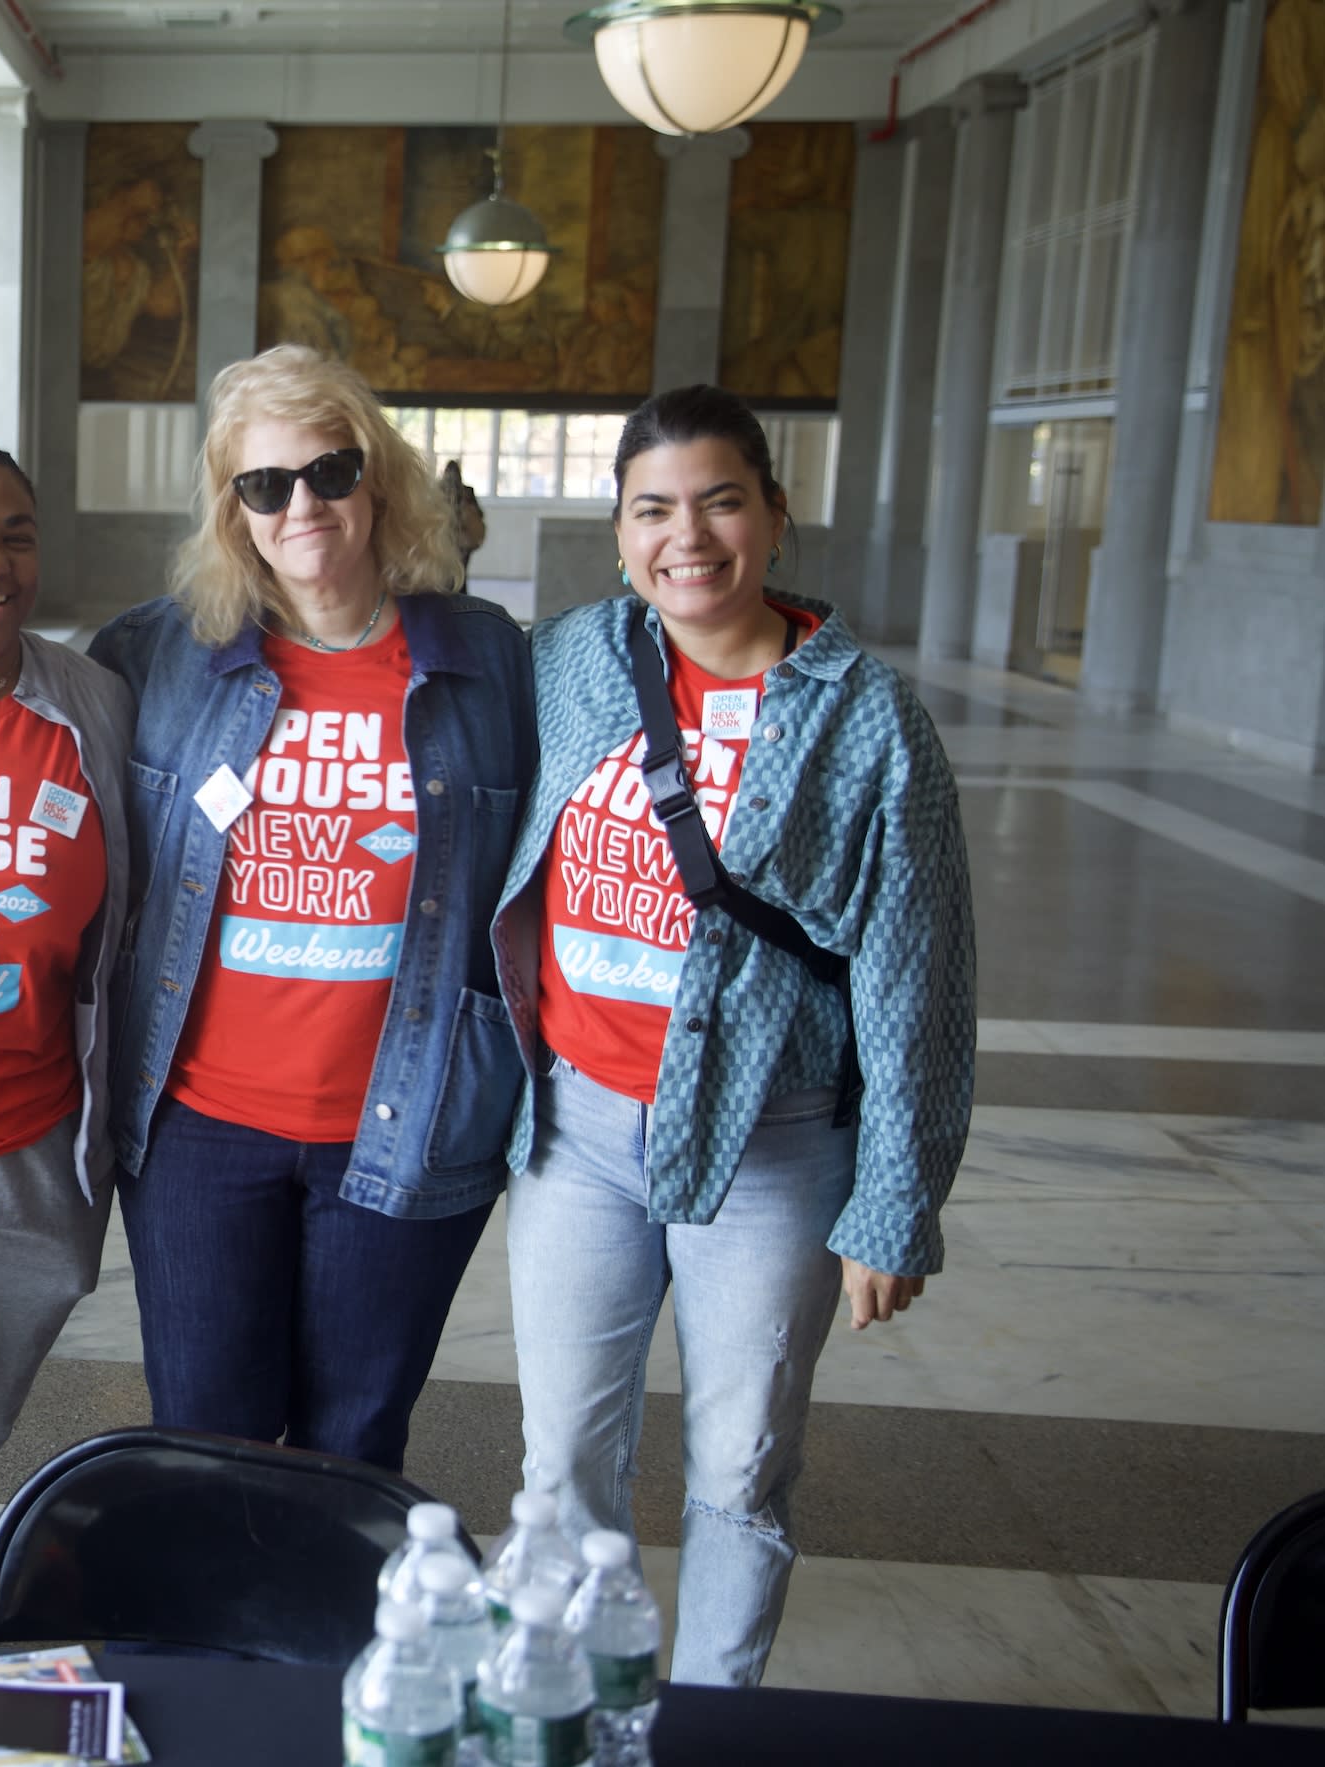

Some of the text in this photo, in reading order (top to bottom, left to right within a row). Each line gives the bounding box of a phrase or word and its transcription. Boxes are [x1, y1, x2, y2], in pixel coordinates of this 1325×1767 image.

[711, 703, 747, 711] HOUSE
[711, 711, 737, 720] NEW
[712, 695, 742, 703] OPEN
[269, 708, 383, 761] PEN
[711, 719, 740, 728] YORK
[242, 756, 417, 811] OUSE
[229, 810, 352, 863] NEW
[369, 836, 413, 850] 2025
[561, 806, 678, 886] NEW
[226, 858, 376, 920] YORK
[561, 861, 698, 947] YORK
[230, 927, 396, 970] Weekend
